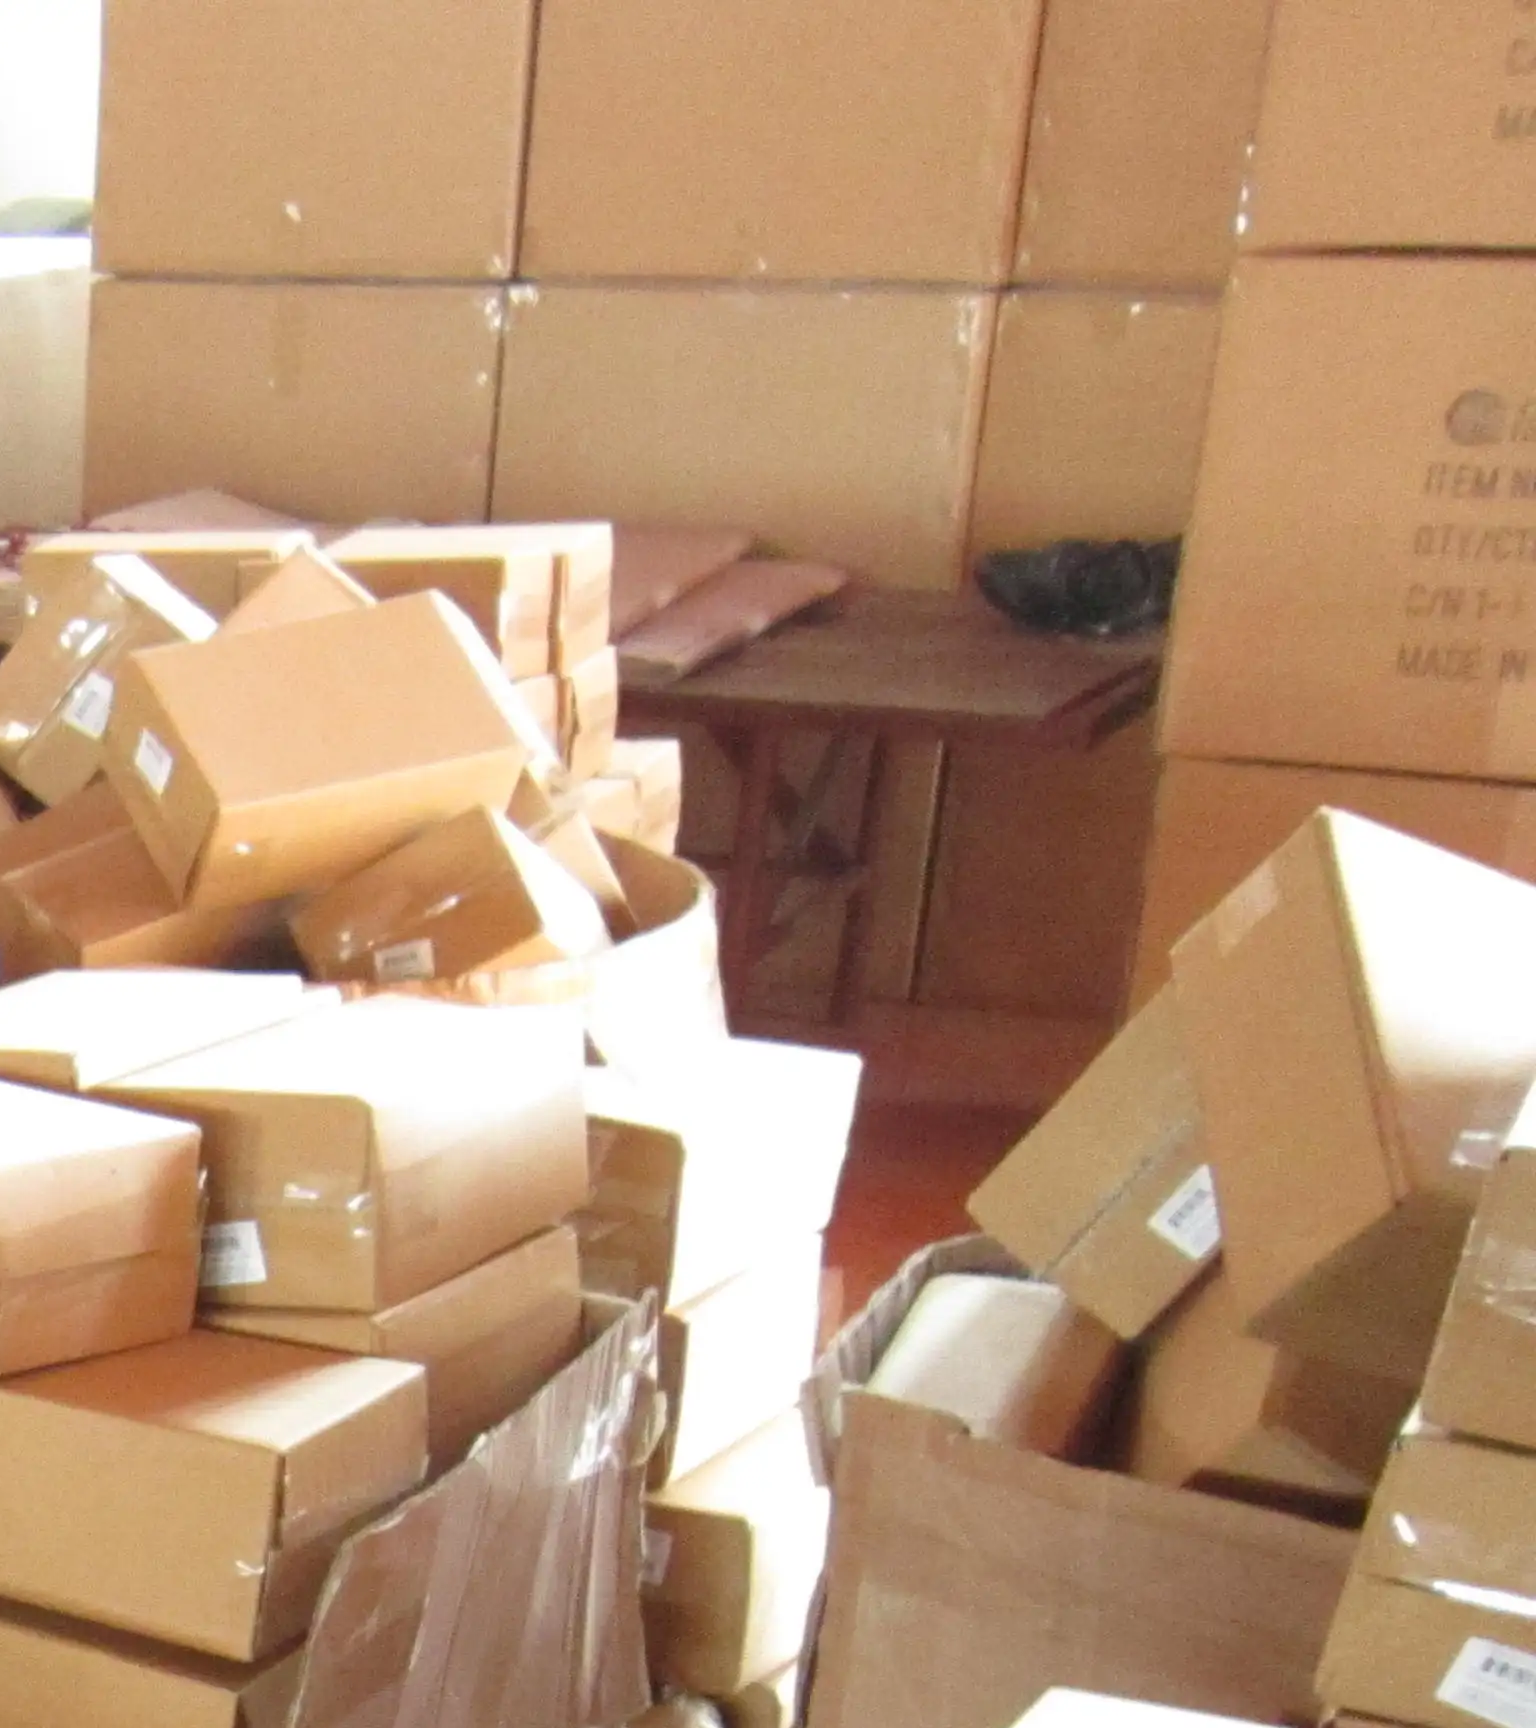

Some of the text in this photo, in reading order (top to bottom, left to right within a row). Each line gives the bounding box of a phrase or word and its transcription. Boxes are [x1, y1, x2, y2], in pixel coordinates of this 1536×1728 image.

[1505, 38, 1536, 77] C
[1425, 461, 1500, 498] ITEM
[1414, 523, 1536, 562] QTY/CT
[1397, 643, 1481, 681] MADE
